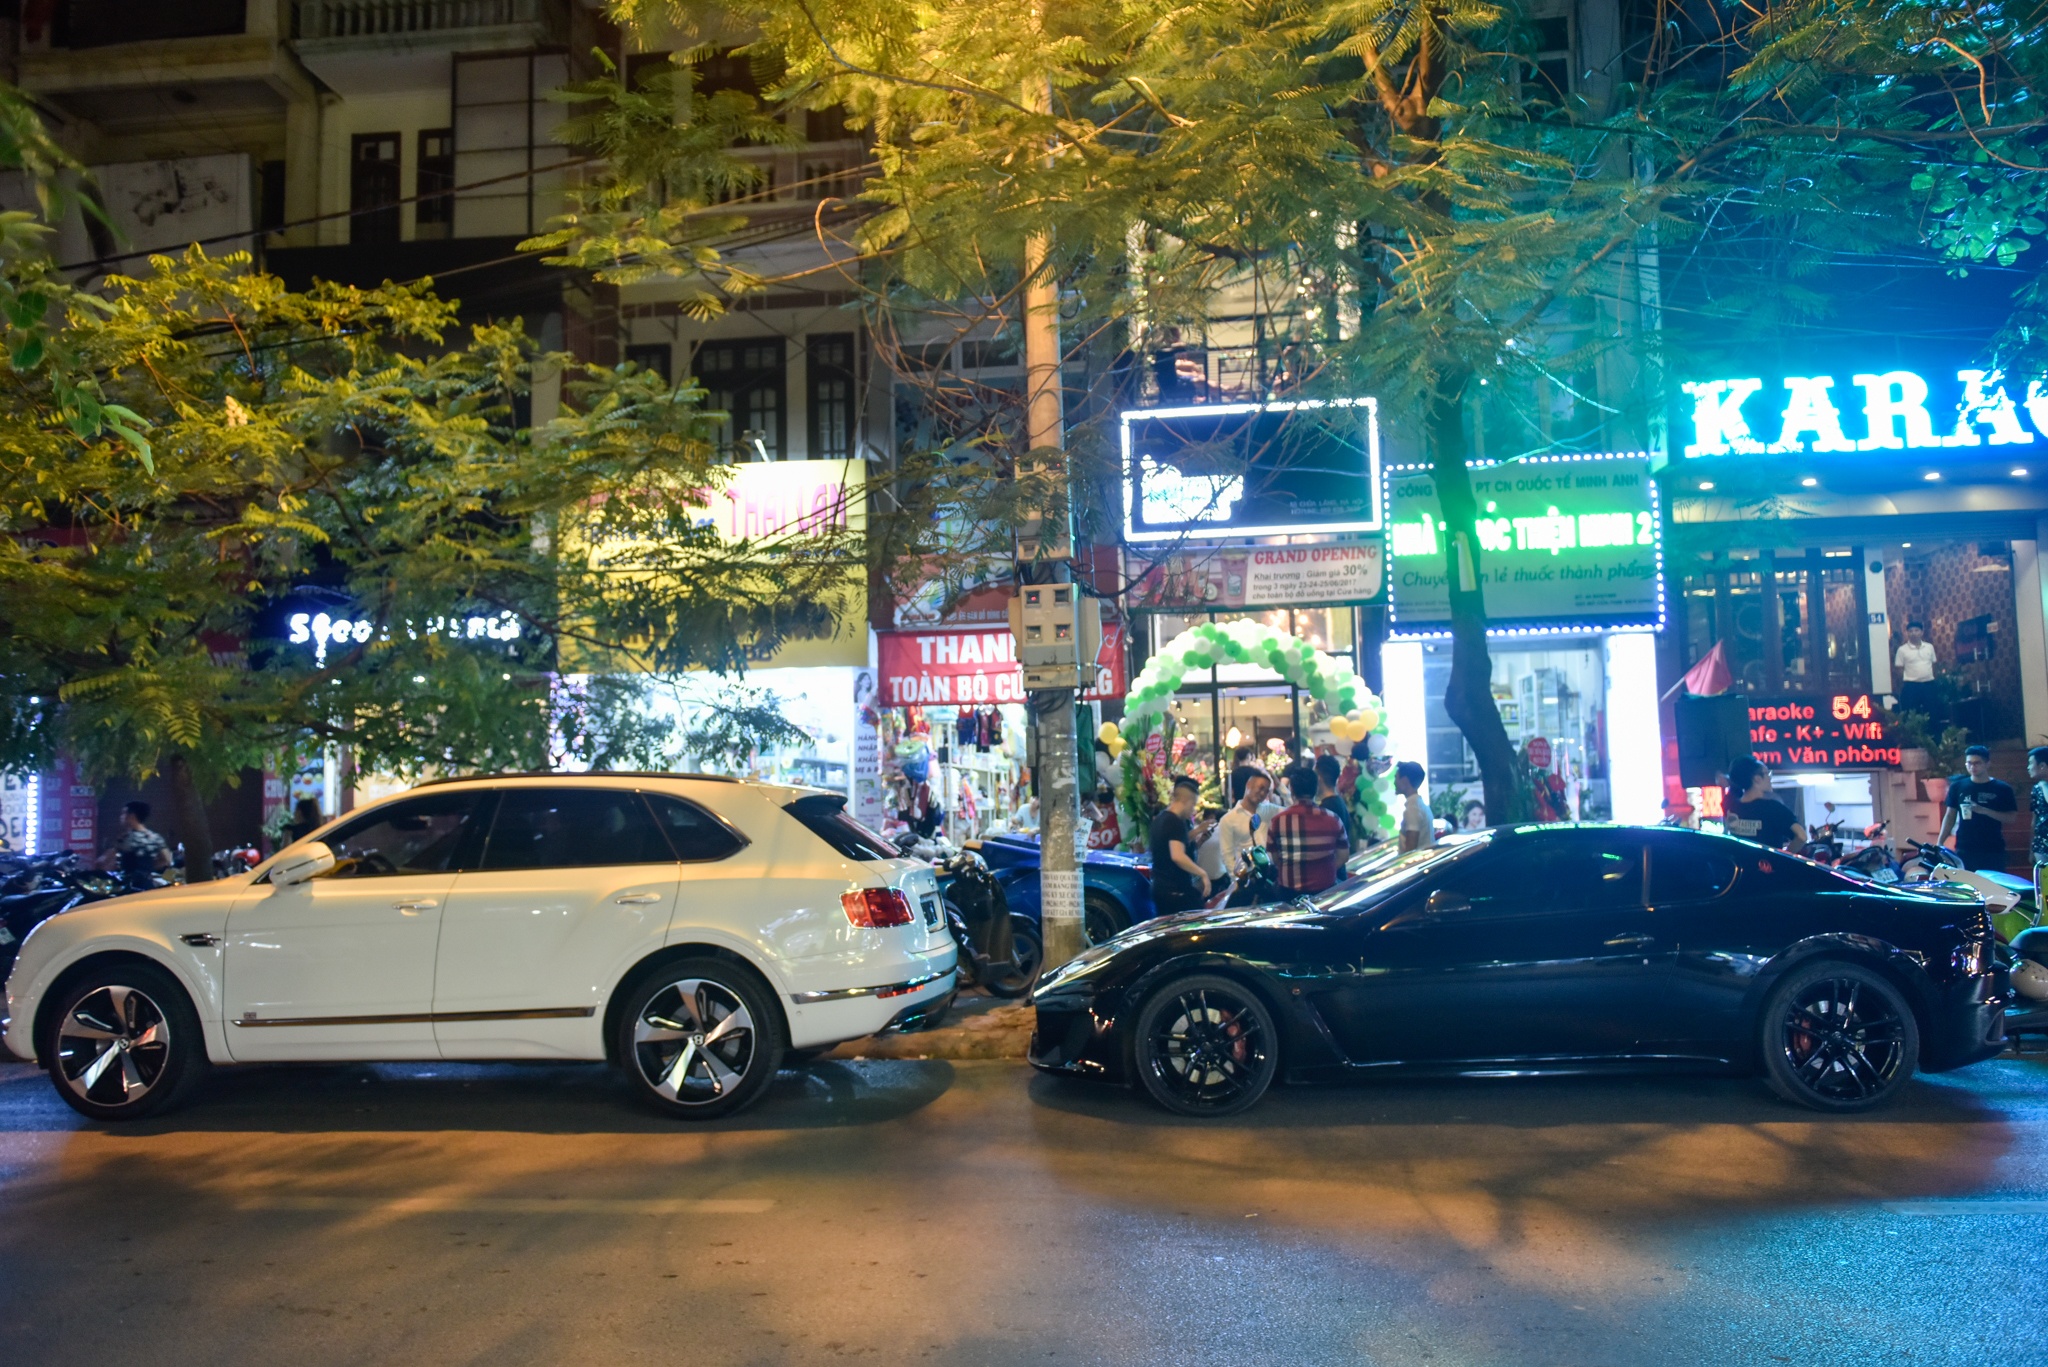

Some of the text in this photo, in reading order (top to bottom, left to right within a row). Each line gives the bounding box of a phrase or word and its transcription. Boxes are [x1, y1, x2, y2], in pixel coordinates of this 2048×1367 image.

[1494, 481, 1512, 492] CN
[1575, 475, 1607, 488] MINH
[1612, 474, 1638, 487] ANH
[1636, 511, 1654, 545] 2
[1254, 545, 1377, 565] GRAND OPENING
[1254, 572, 1271, 580] Khai
[1343, 564, 1368, 576] 30%
[1402, 570, 1449, 588] Chuyê
[1560, 563, 1602, 580] thành
[1869, 613, 1883, 623] 54
[890, 670, 951, 703] TOÀN
[994, 665, 1028, 700] CỬ
[1832, 694, 1872, 720] 54
[1796, 724, 1825, 742] K+
[1787, 746, 1828, 764] Văn
[1833, 745, 1901, 766] phòng
